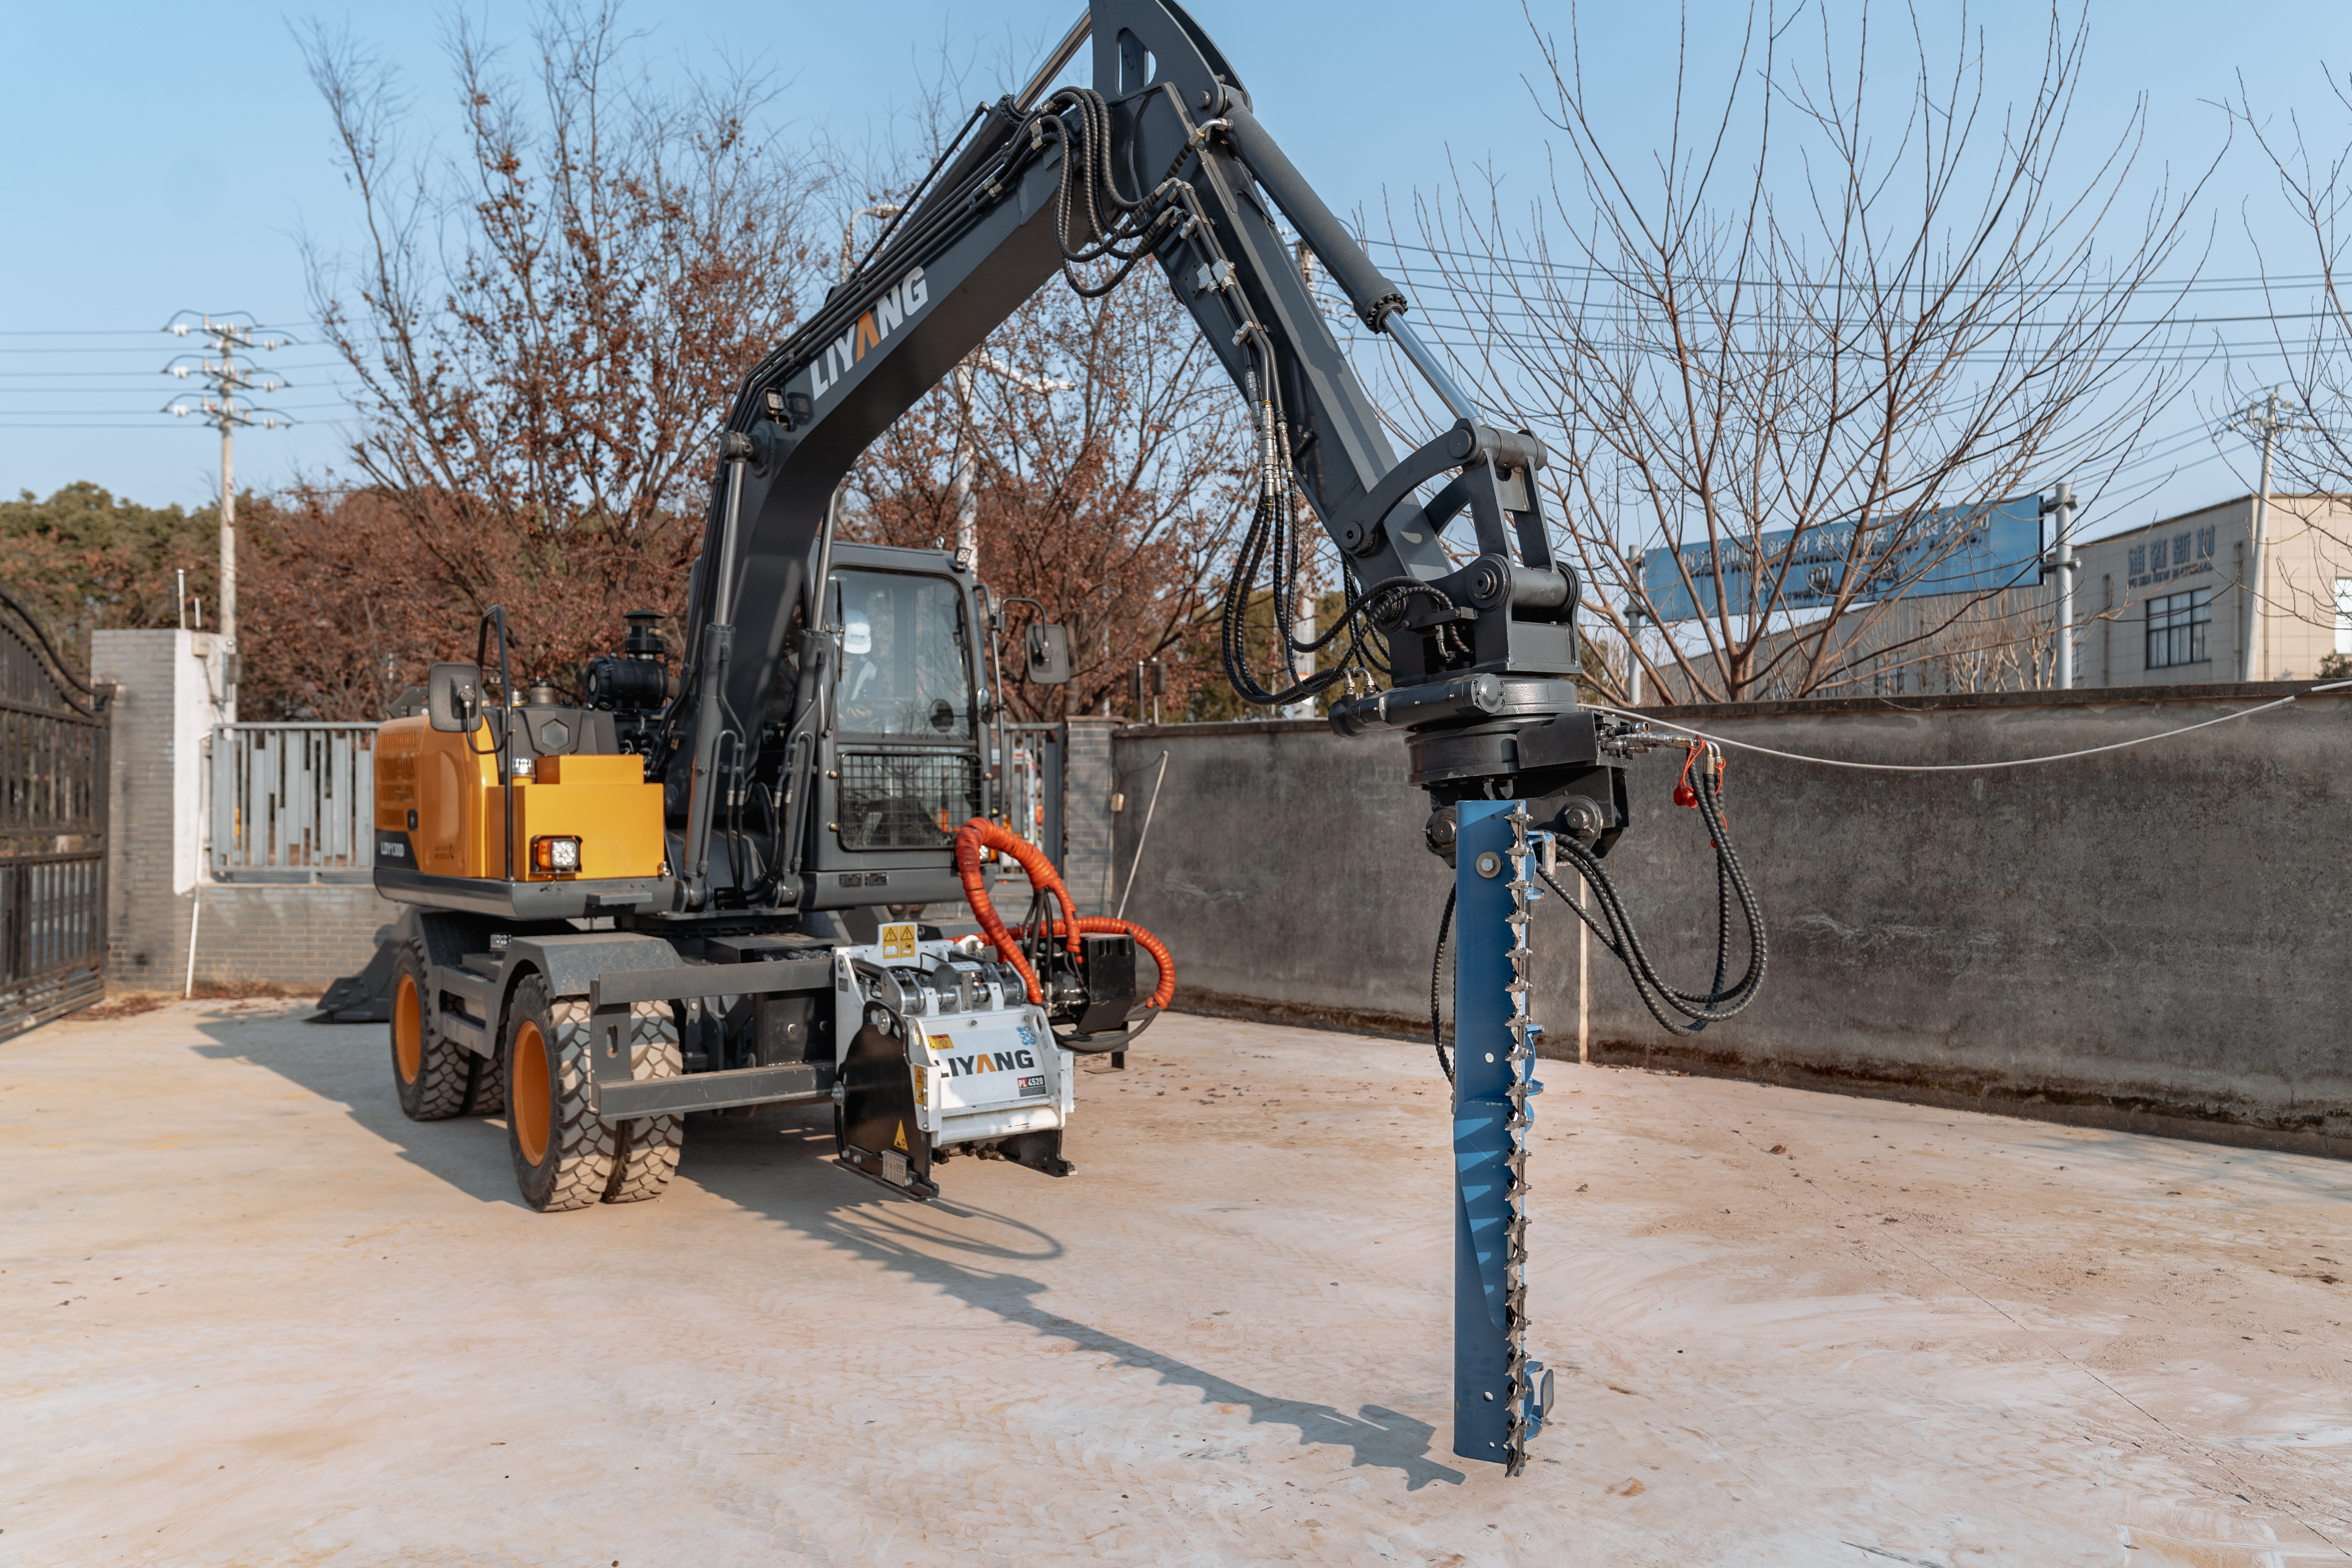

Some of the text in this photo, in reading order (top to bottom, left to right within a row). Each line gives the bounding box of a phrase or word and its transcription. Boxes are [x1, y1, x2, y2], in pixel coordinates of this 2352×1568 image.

[810, 266, 929, 401] LIYANG
[1018, 1077, 1044, 1087] PL 4520
